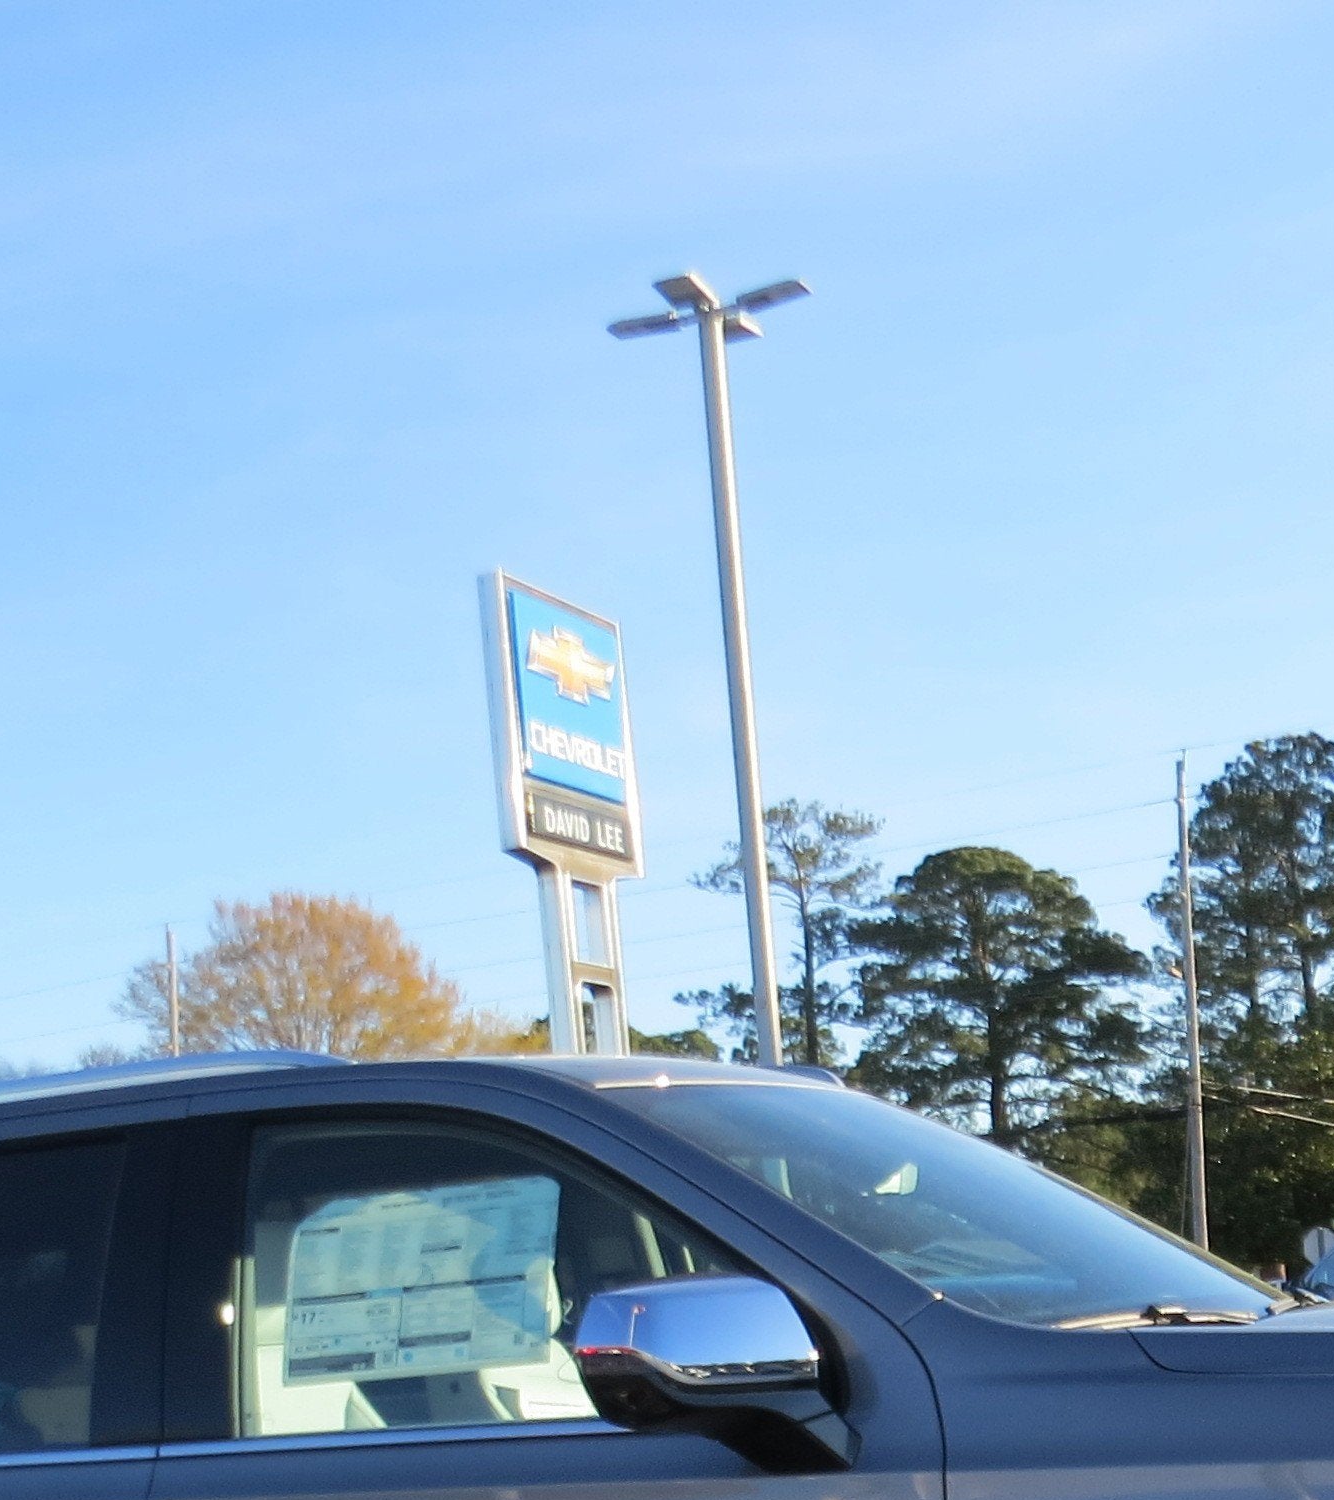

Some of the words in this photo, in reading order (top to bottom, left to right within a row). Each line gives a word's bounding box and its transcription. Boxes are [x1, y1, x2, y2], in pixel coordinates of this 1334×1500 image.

[529, 721, 625, 778] CHEVROLET
[544, 805, 590, 842] DAVID
[596, 820, 625, 853] LEE
